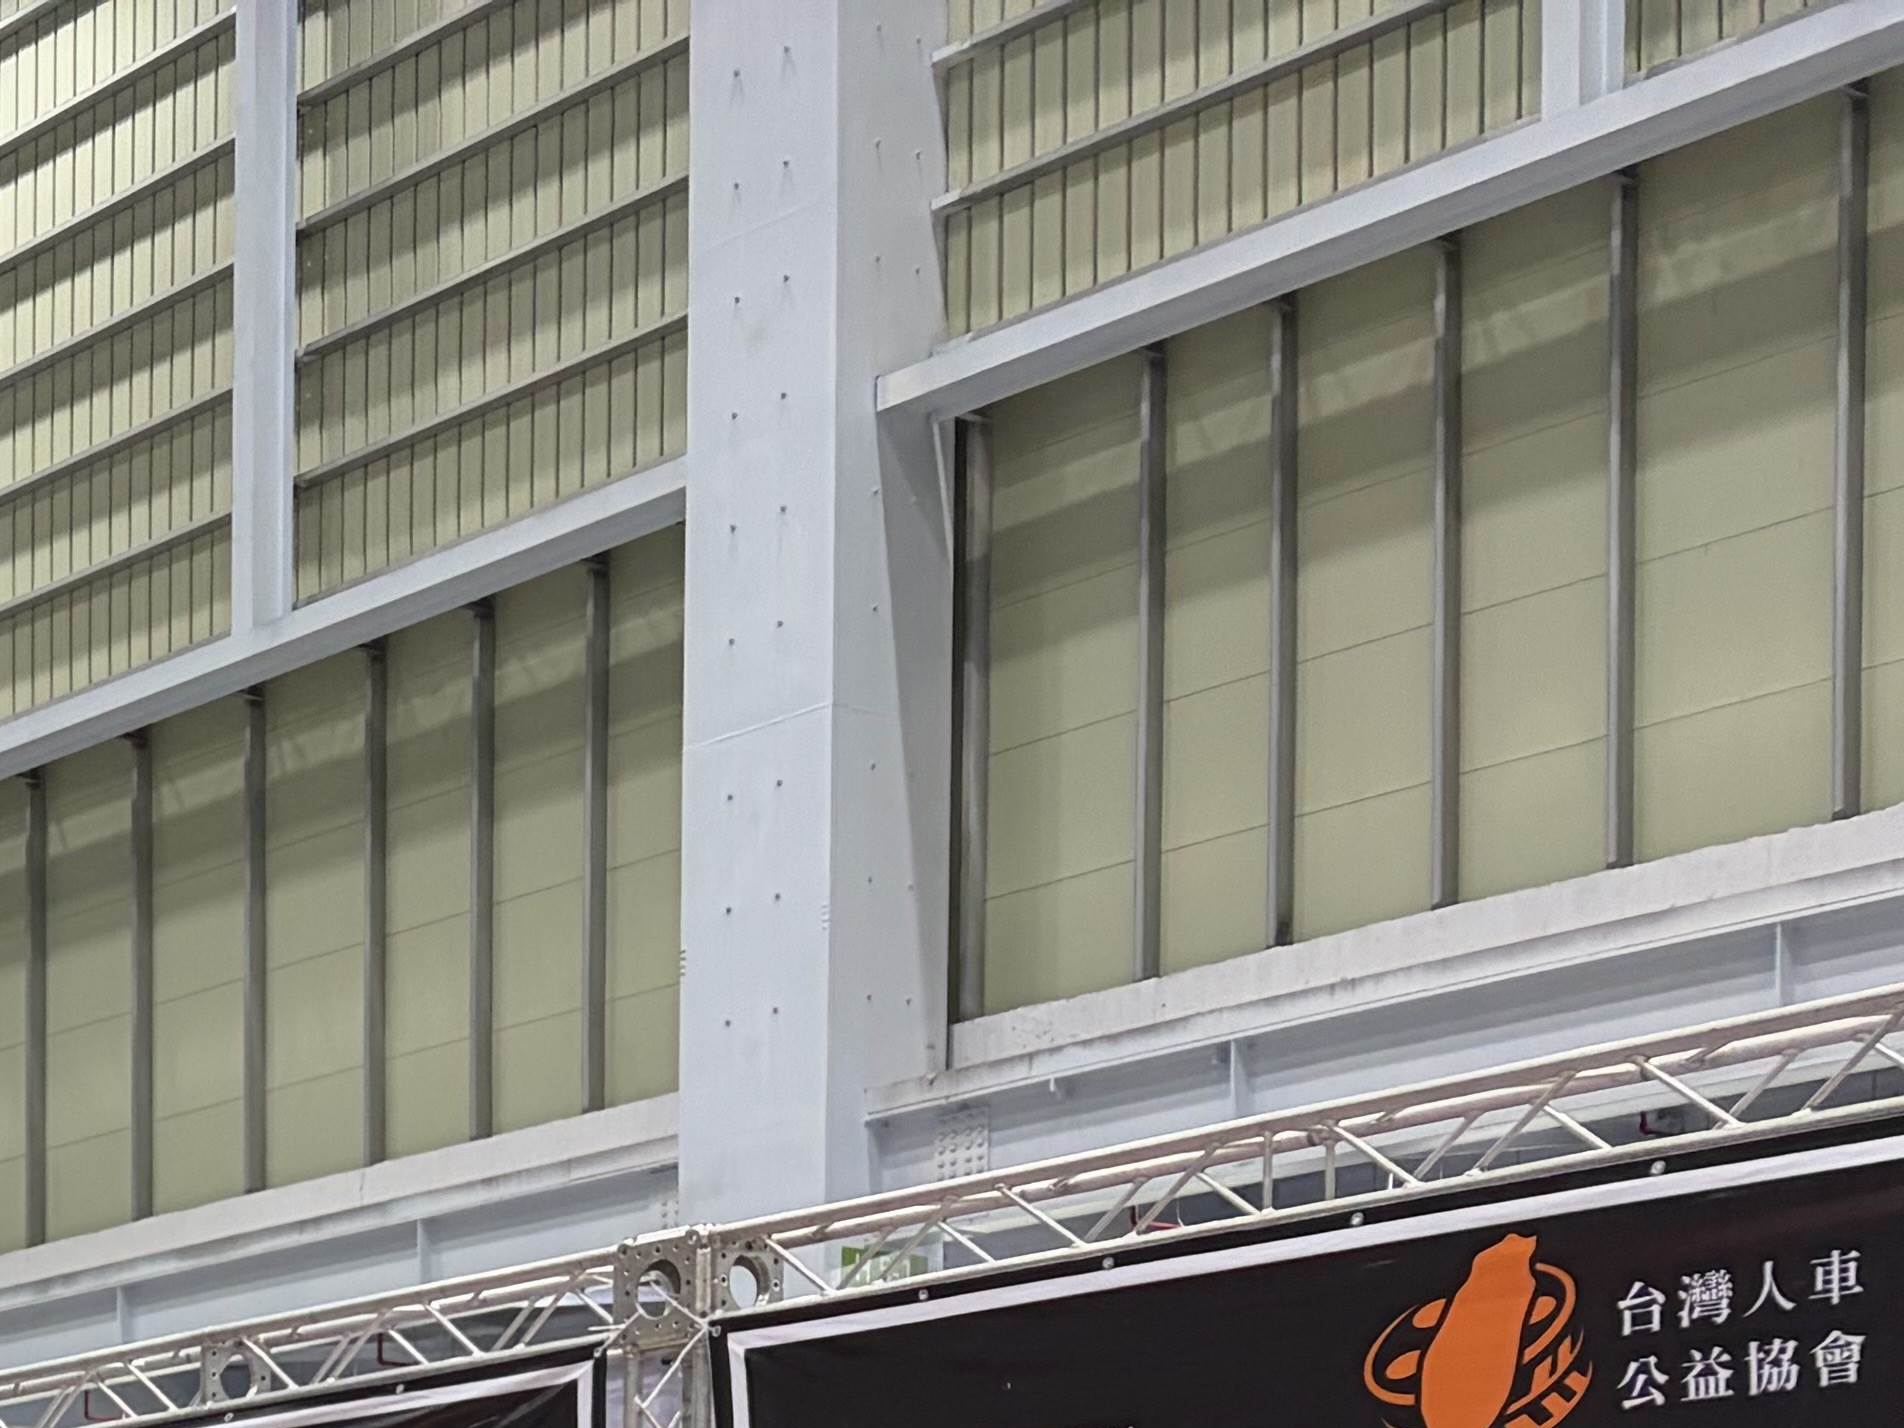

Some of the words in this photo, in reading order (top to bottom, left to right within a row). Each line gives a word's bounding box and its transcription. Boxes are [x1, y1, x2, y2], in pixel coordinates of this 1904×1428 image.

[1617, 1249, 1865, 1337] 台灣人車
[1616, 1329, 1866, 1410] 公益協會
